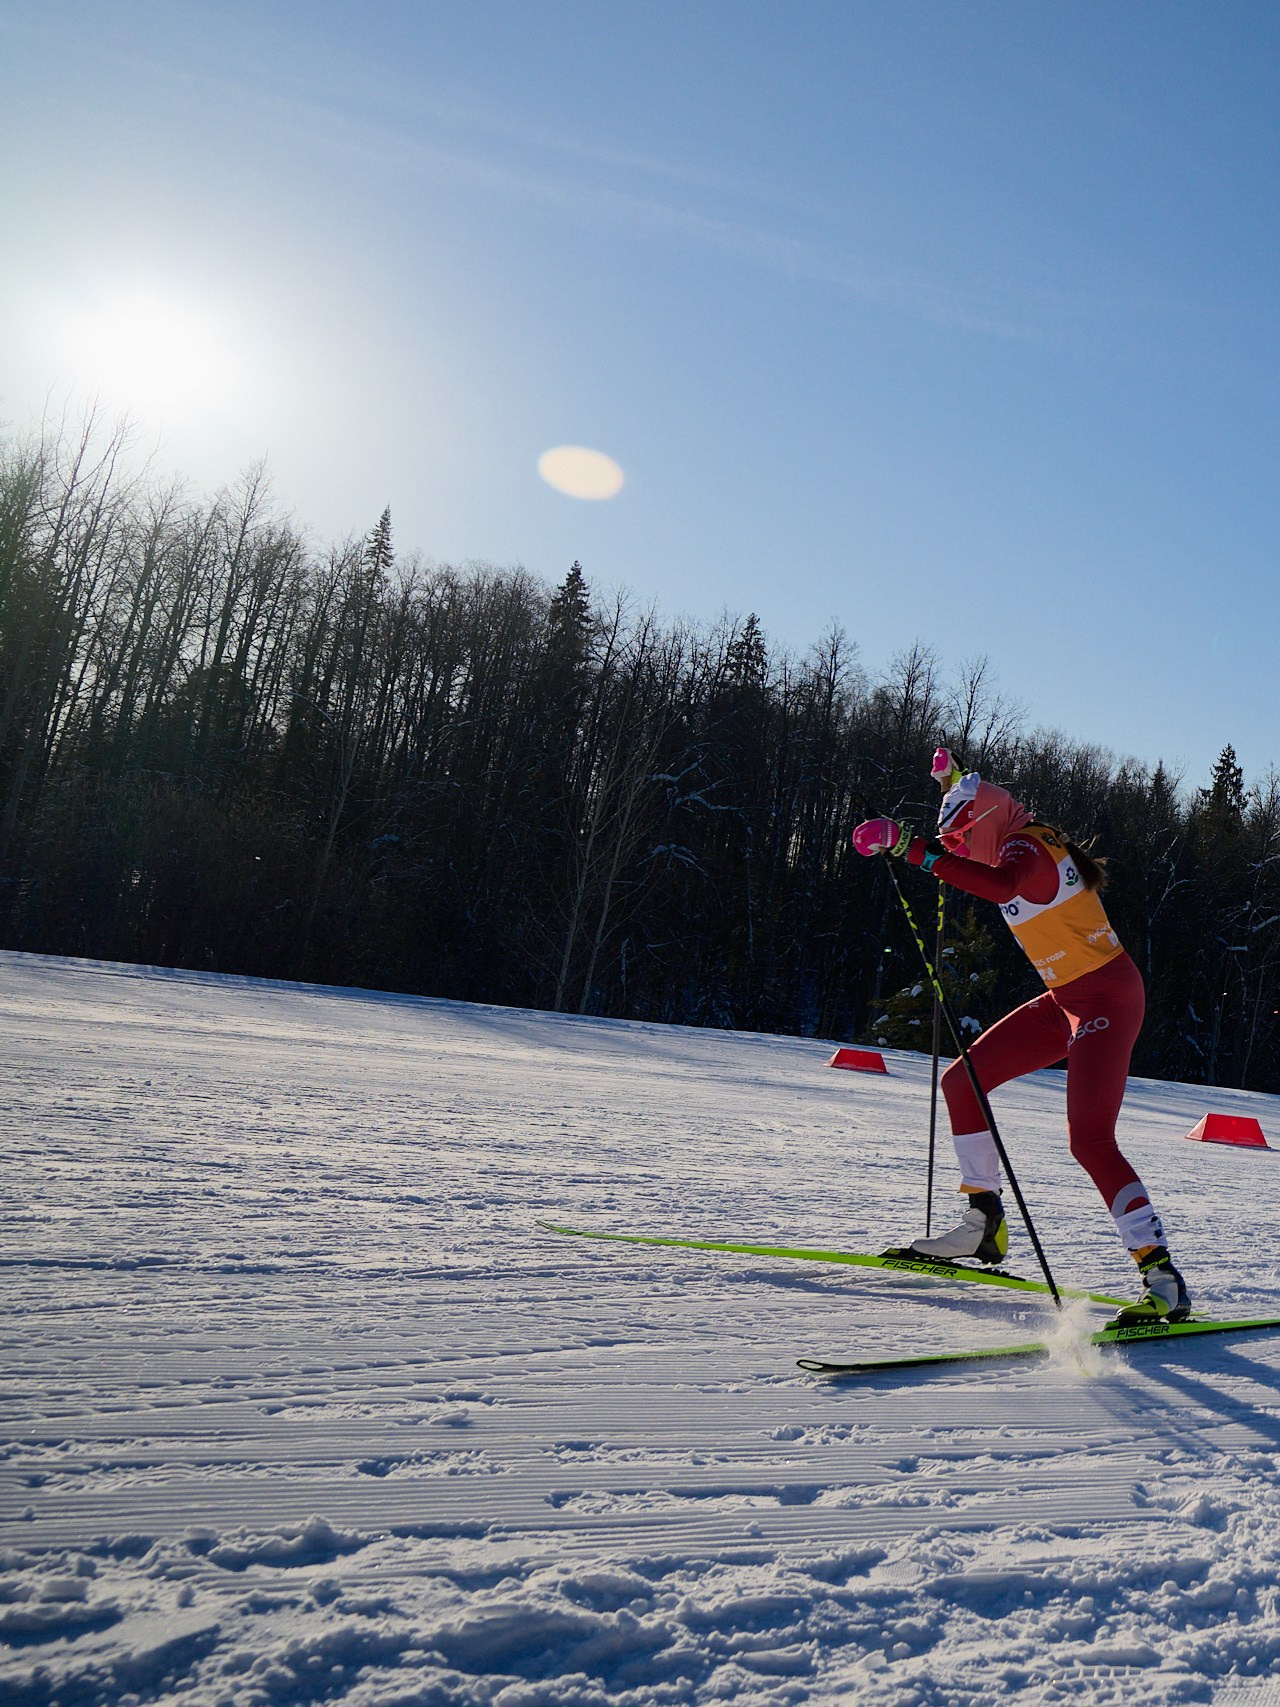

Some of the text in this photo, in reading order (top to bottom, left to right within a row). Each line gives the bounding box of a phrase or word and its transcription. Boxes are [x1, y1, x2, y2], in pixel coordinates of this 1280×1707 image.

[1067, 1016, 1110, 1050] OSCO
[881, 1259, 958, 1277] FISCHER
[1117, 1325, 1170, 1339] FISCHER
